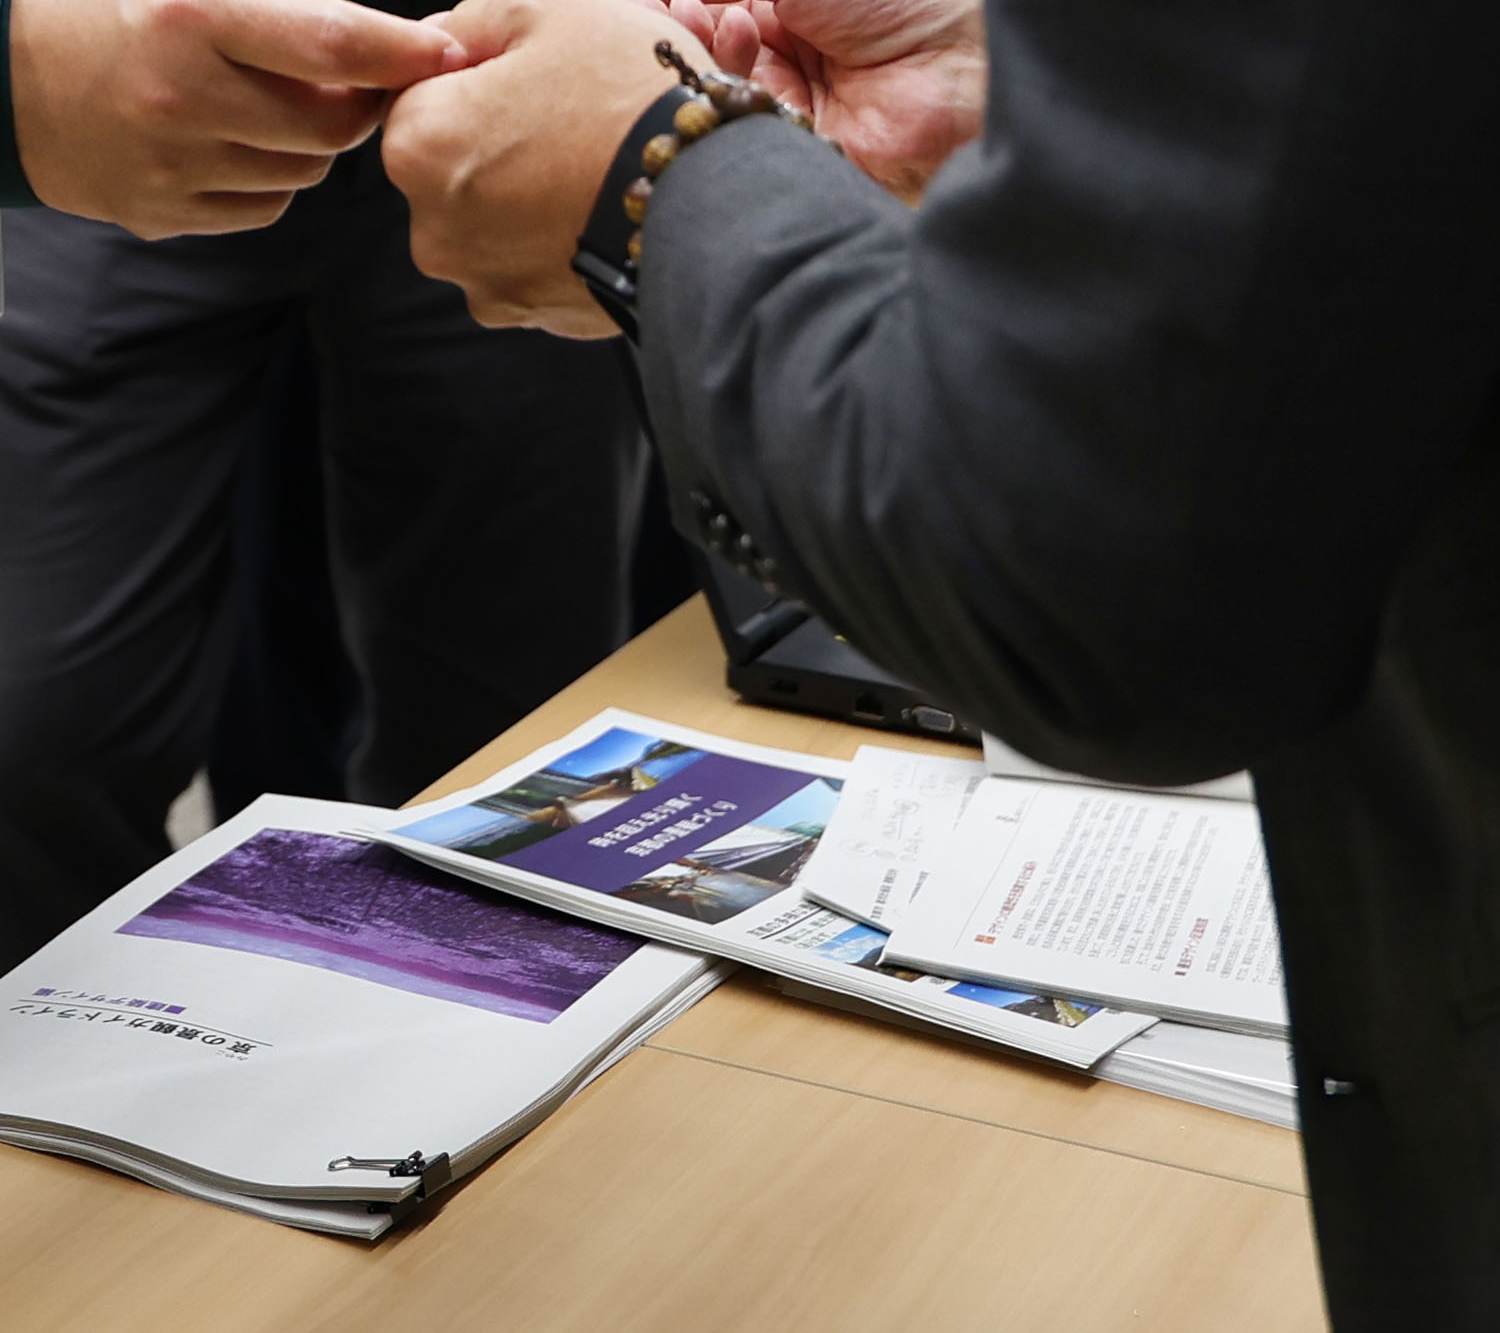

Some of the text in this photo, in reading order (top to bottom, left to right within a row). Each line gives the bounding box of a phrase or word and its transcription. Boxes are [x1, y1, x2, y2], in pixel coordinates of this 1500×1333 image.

[9, 1004, 257, 1056] 京の景観ガイドライン
